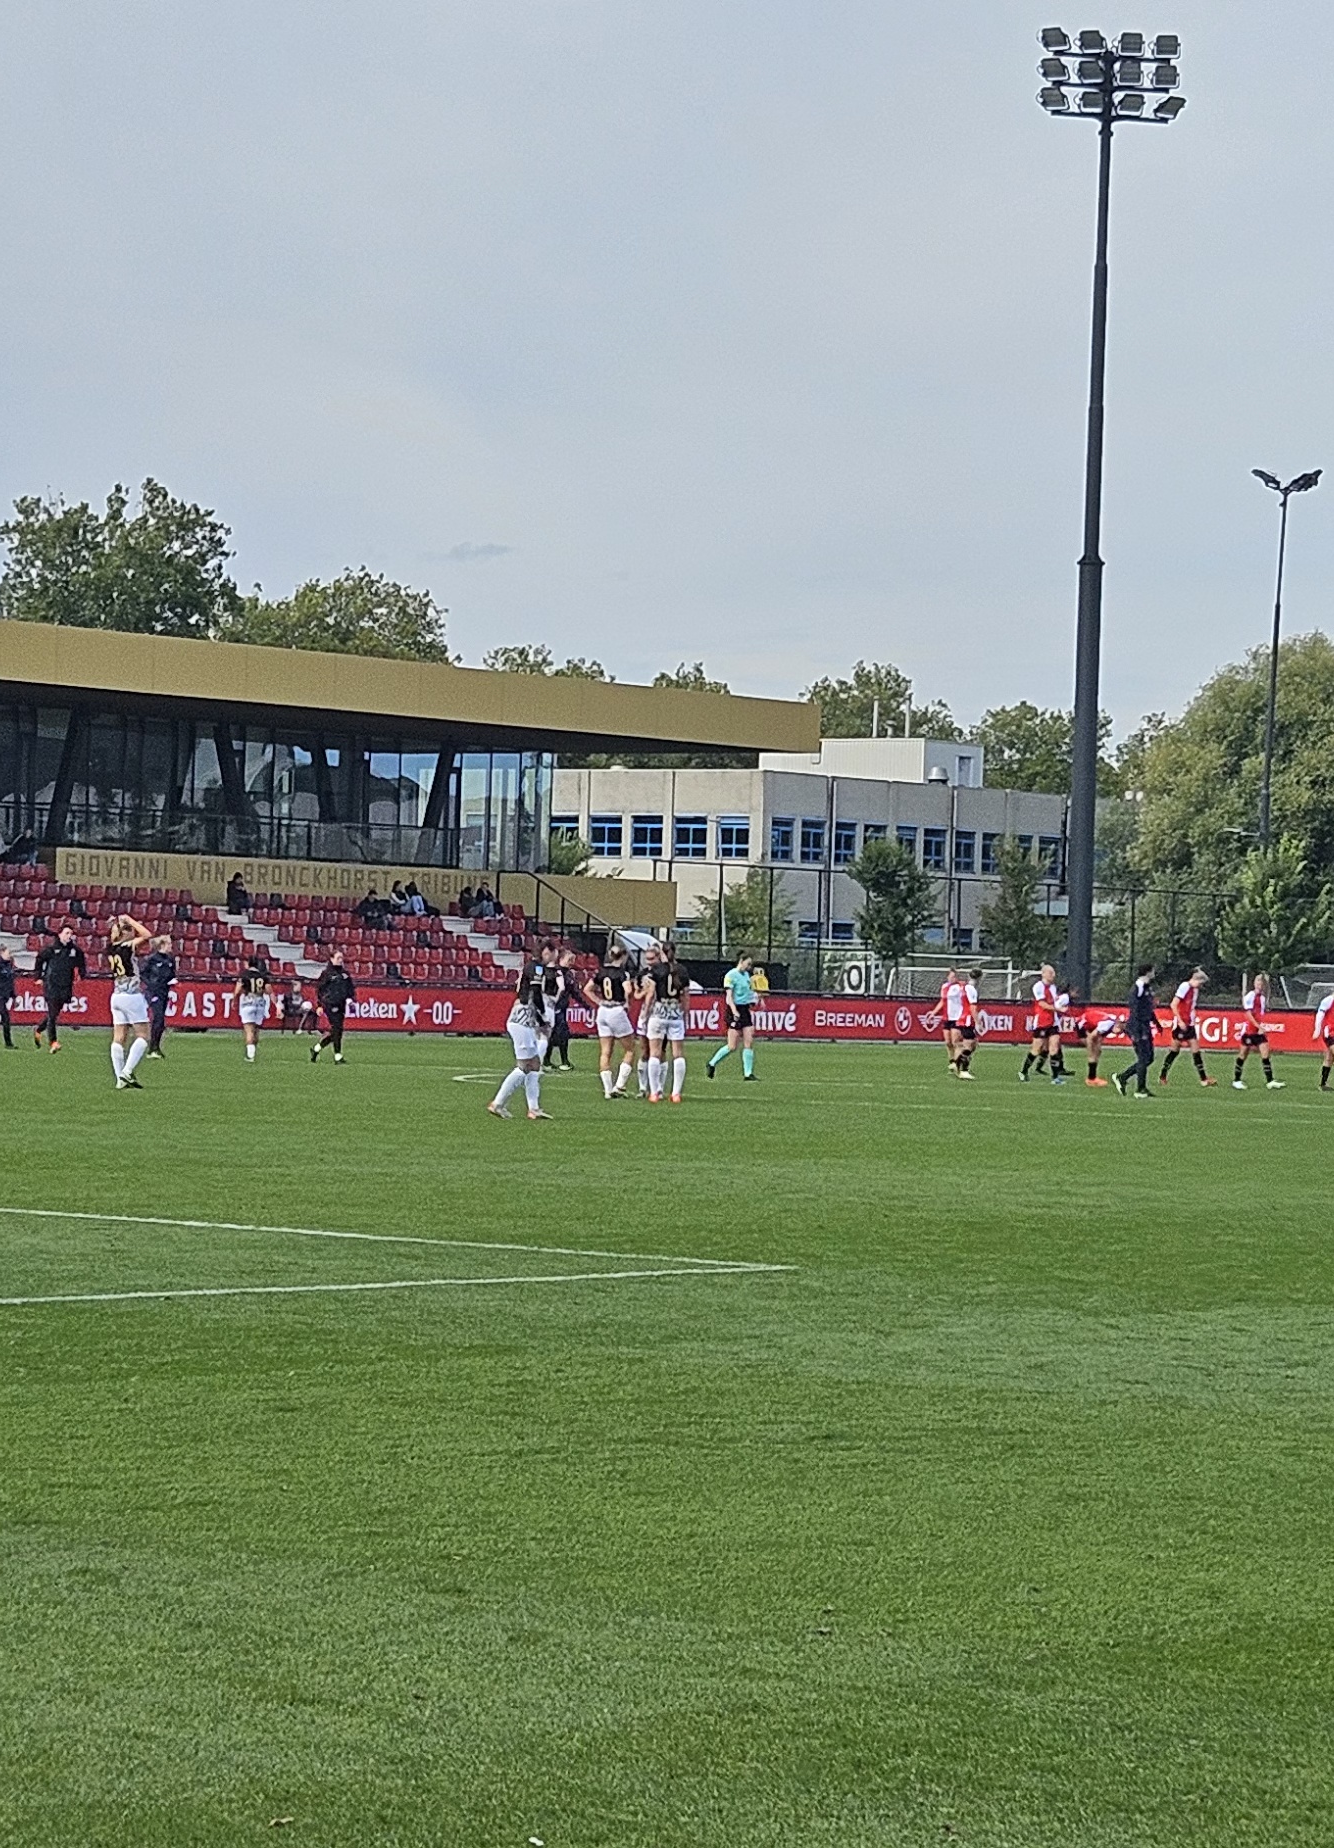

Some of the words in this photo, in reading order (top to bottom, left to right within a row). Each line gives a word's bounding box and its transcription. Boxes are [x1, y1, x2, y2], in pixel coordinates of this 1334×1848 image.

[65, 852, 169, 881] GIOVANNI
[186, 860, 226, 884] VAN
[243, 863, 391, 893] BRONCKHORST
[603, 977, 613, 1000] 8
